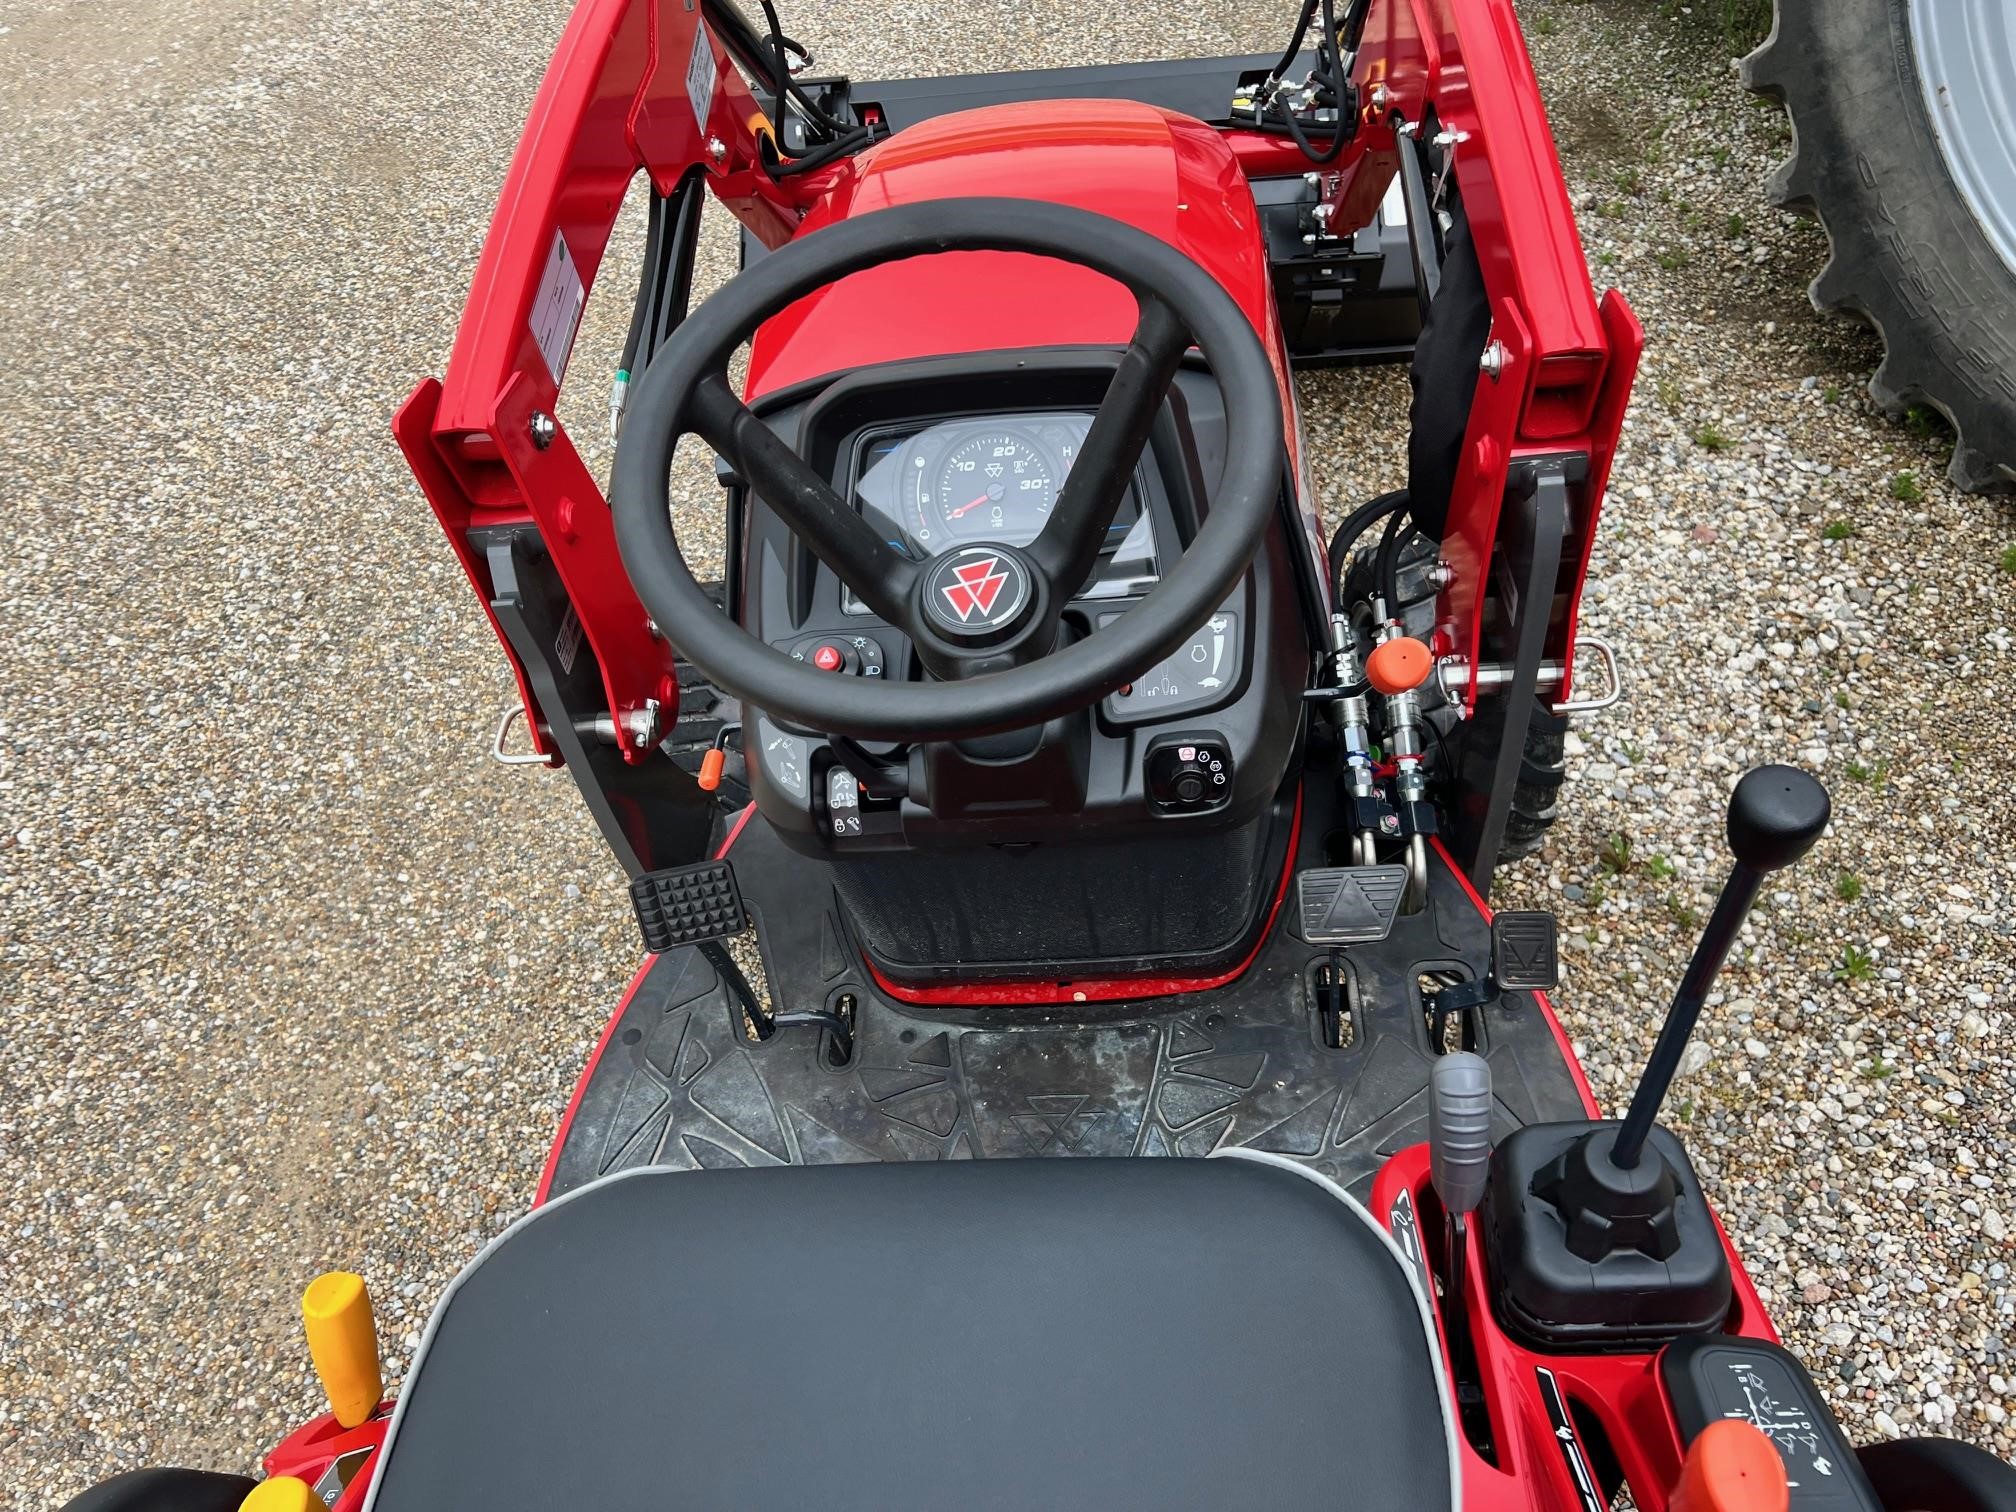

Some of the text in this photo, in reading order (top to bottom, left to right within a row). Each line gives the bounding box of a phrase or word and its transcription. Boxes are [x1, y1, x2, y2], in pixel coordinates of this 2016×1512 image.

[992, 446, 1016, 457] 20
[1062, 446, 1072, 457] H
[956, 461, 976, 472] 10
[1020, 479, 1043, 490] 30
